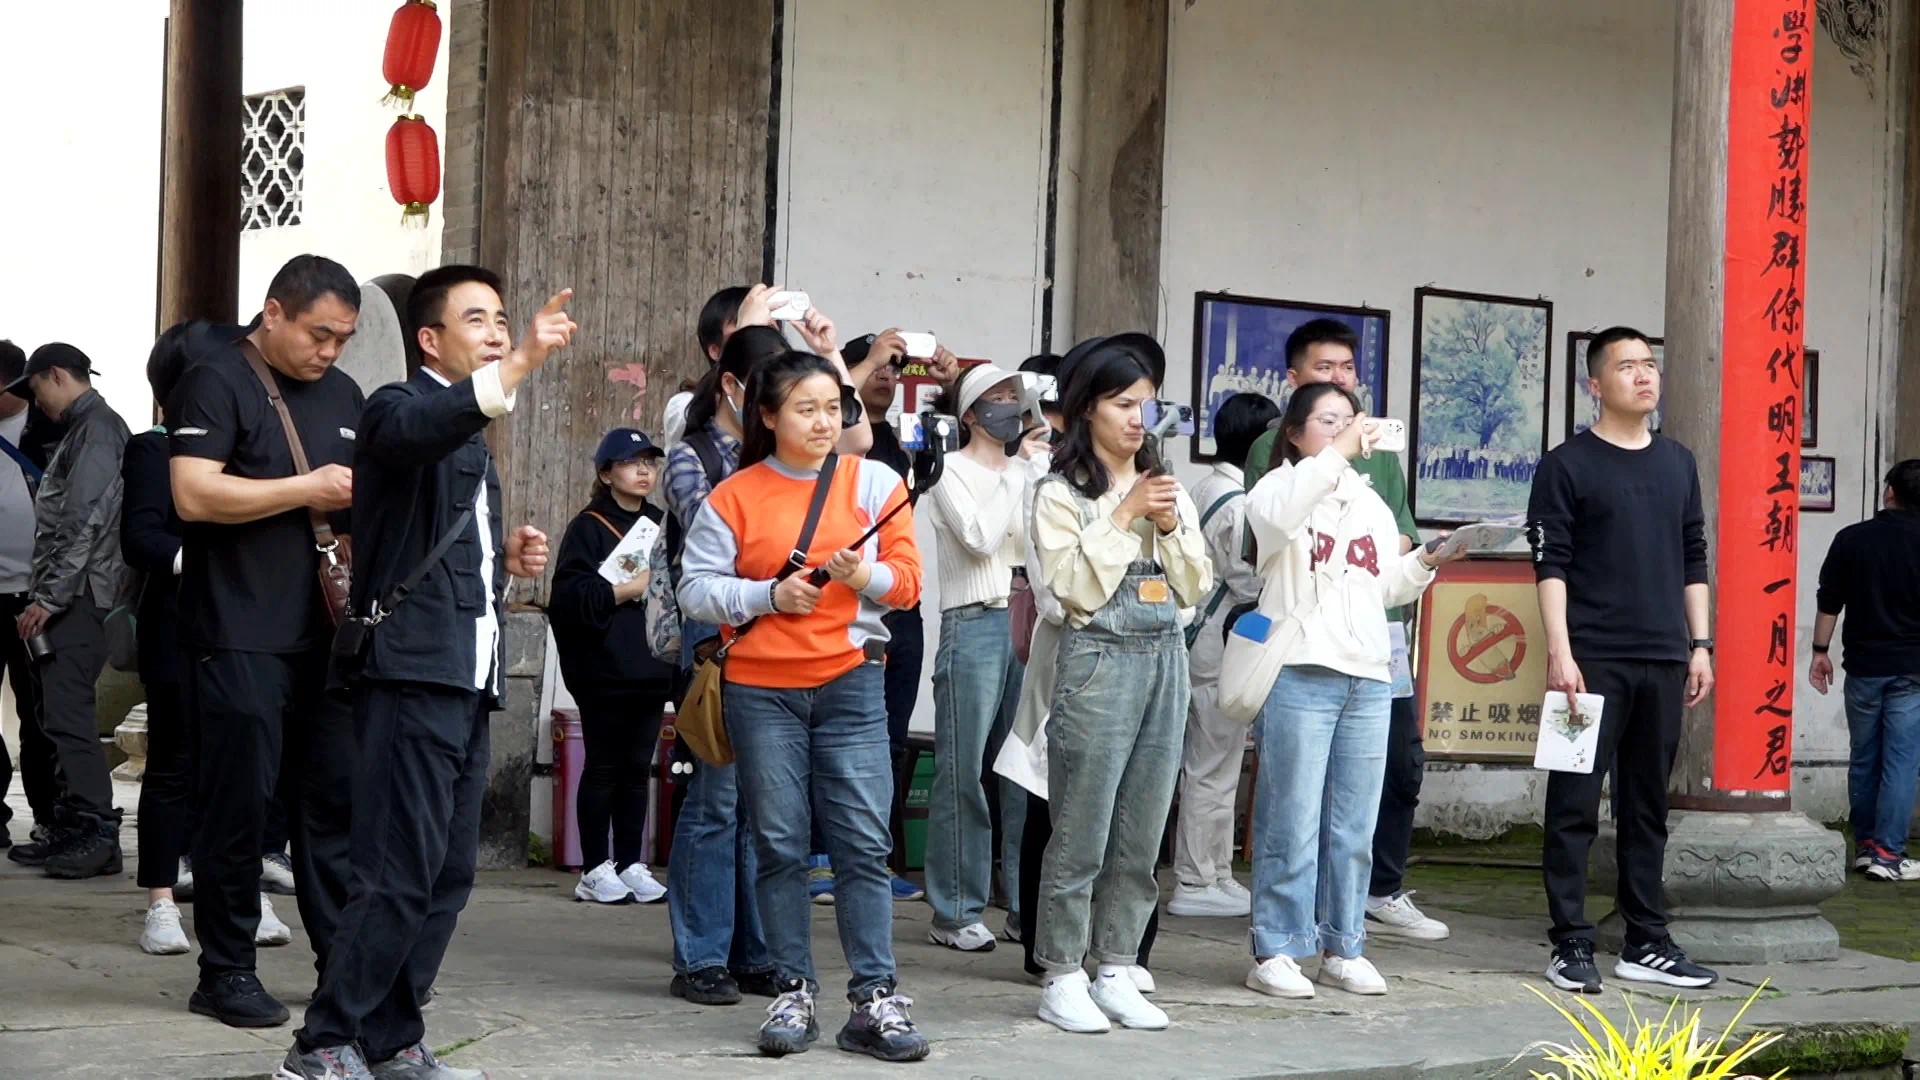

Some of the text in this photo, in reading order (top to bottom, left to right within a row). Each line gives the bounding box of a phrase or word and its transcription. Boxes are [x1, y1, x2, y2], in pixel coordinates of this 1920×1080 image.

[1431, 702, 1540, 725] 禁止吸烟
[1428, 728, 1538, 742] NO SMOKING
